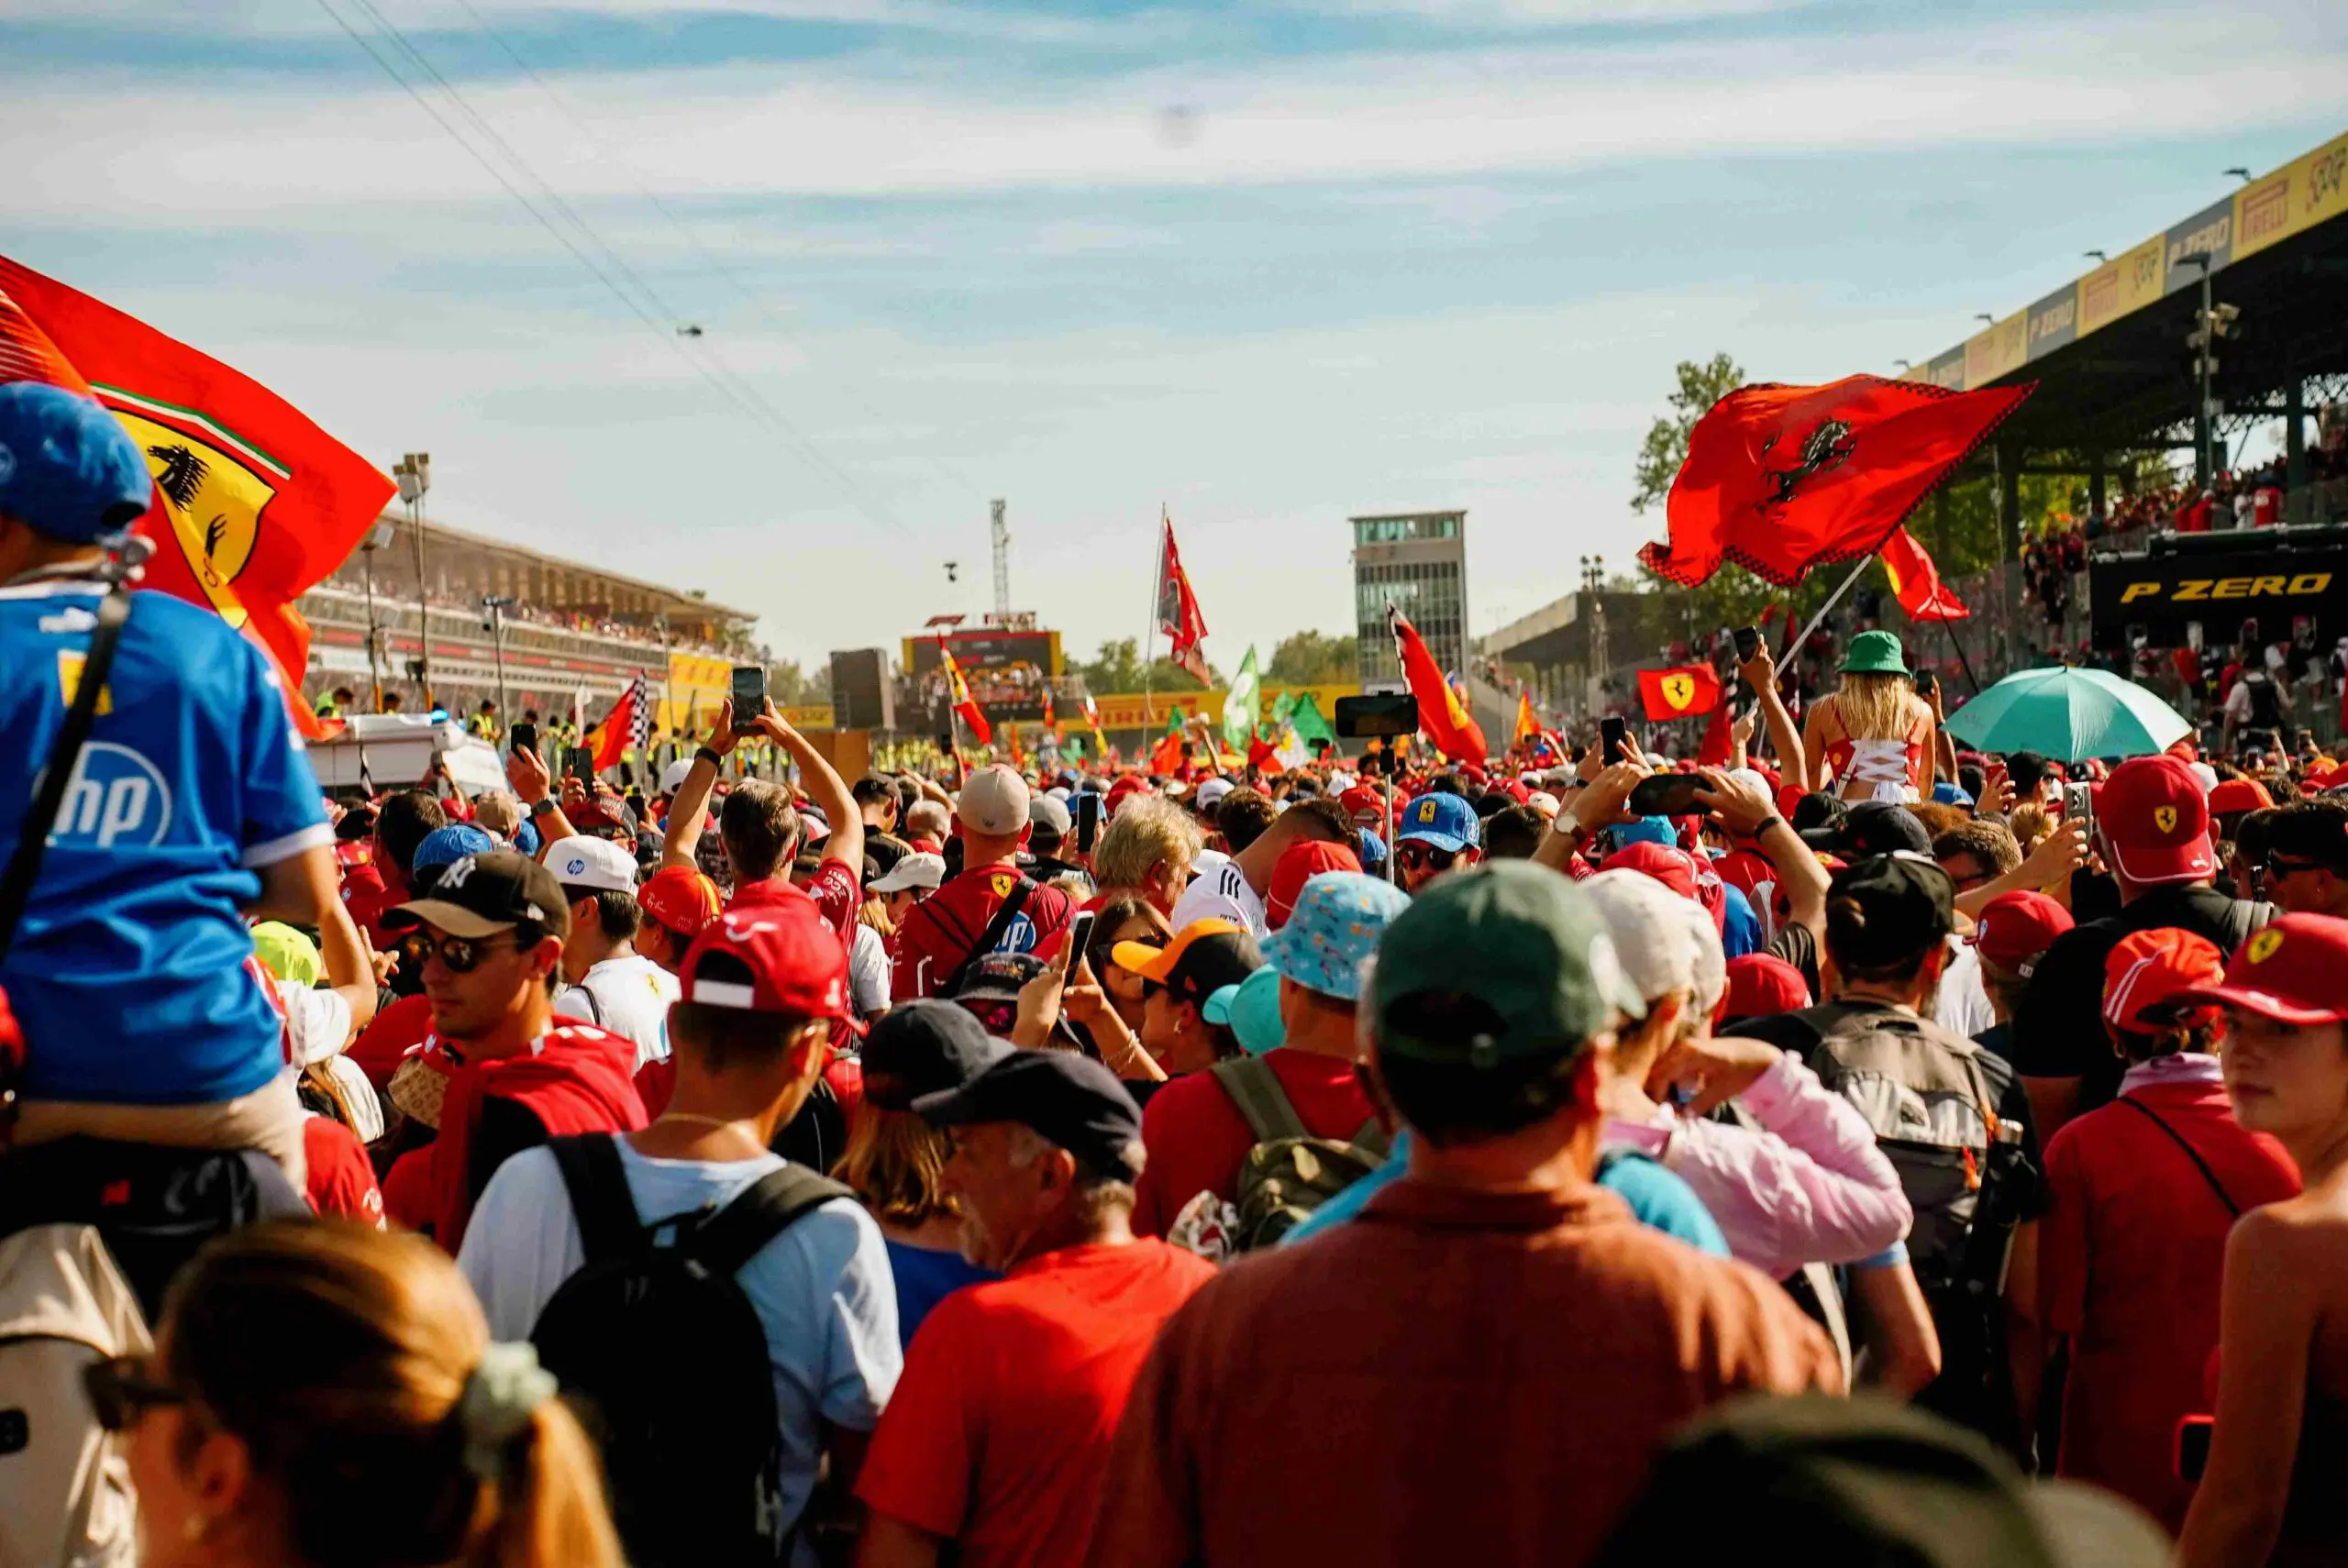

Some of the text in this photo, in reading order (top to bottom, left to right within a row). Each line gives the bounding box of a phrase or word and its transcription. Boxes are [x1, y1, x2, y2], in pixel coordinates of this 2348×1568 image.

[2121, 573, 2332, 603] P ZERO
[52, 741, 151, 848] hp
[567, 859, 585, 876] hp
